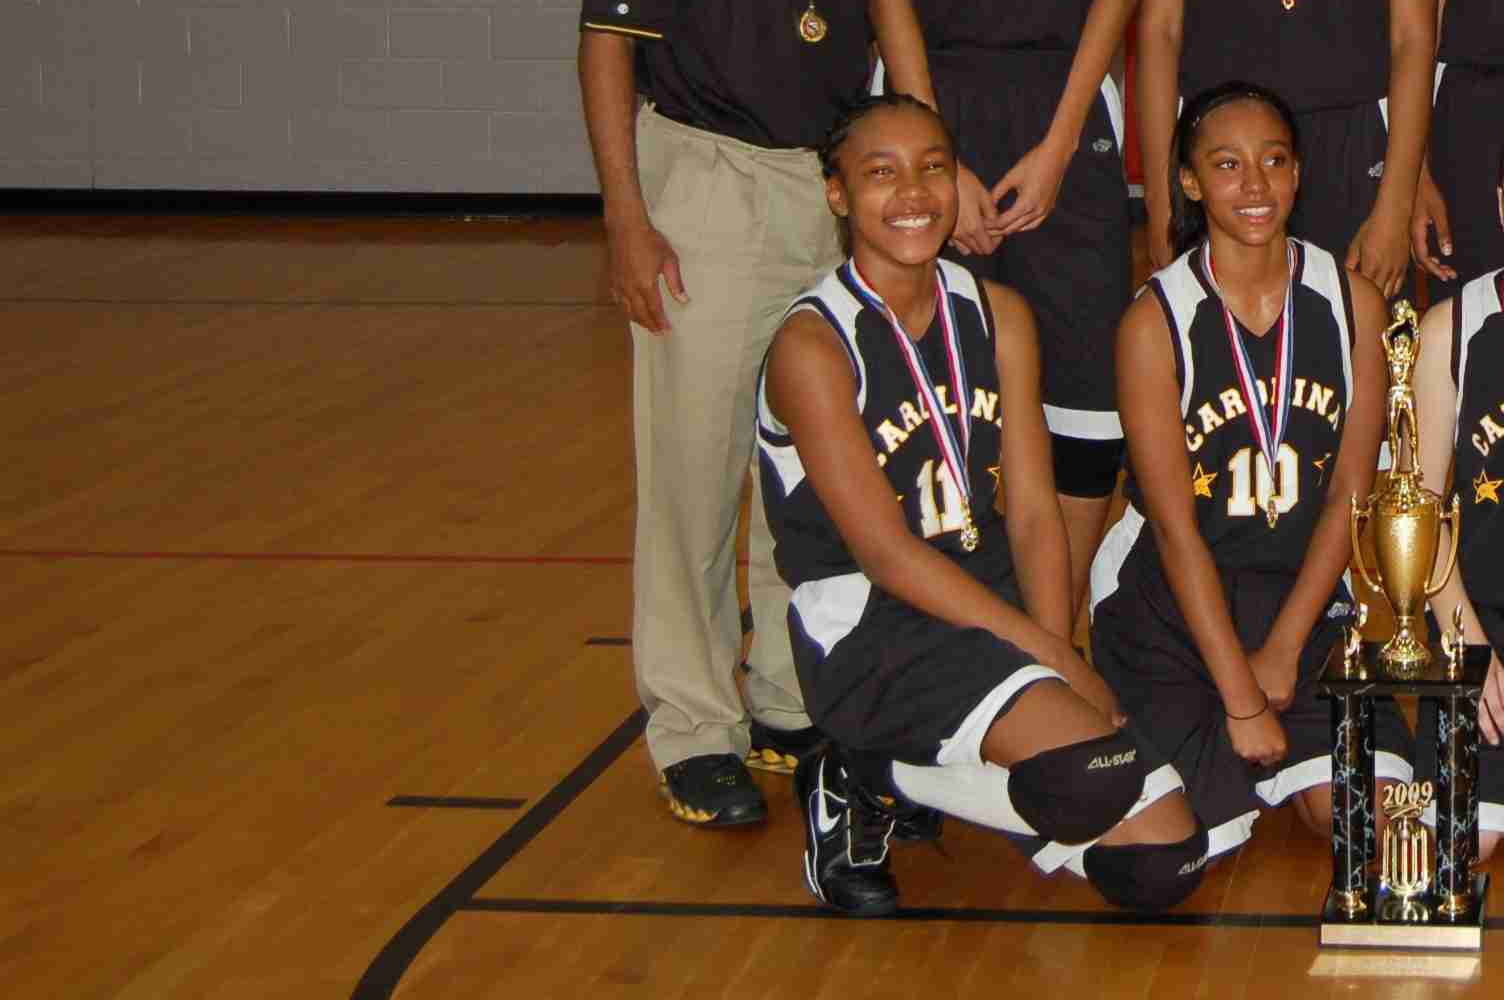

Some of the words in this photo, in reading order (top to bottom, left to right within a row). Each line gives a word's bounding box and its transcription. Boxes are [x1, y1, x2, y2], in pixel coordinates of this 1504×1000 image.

[916, 458, 967, 539] 11
[1227, 443, 1300, 517] 10
[1382, 780, 1433, 807] 2009
